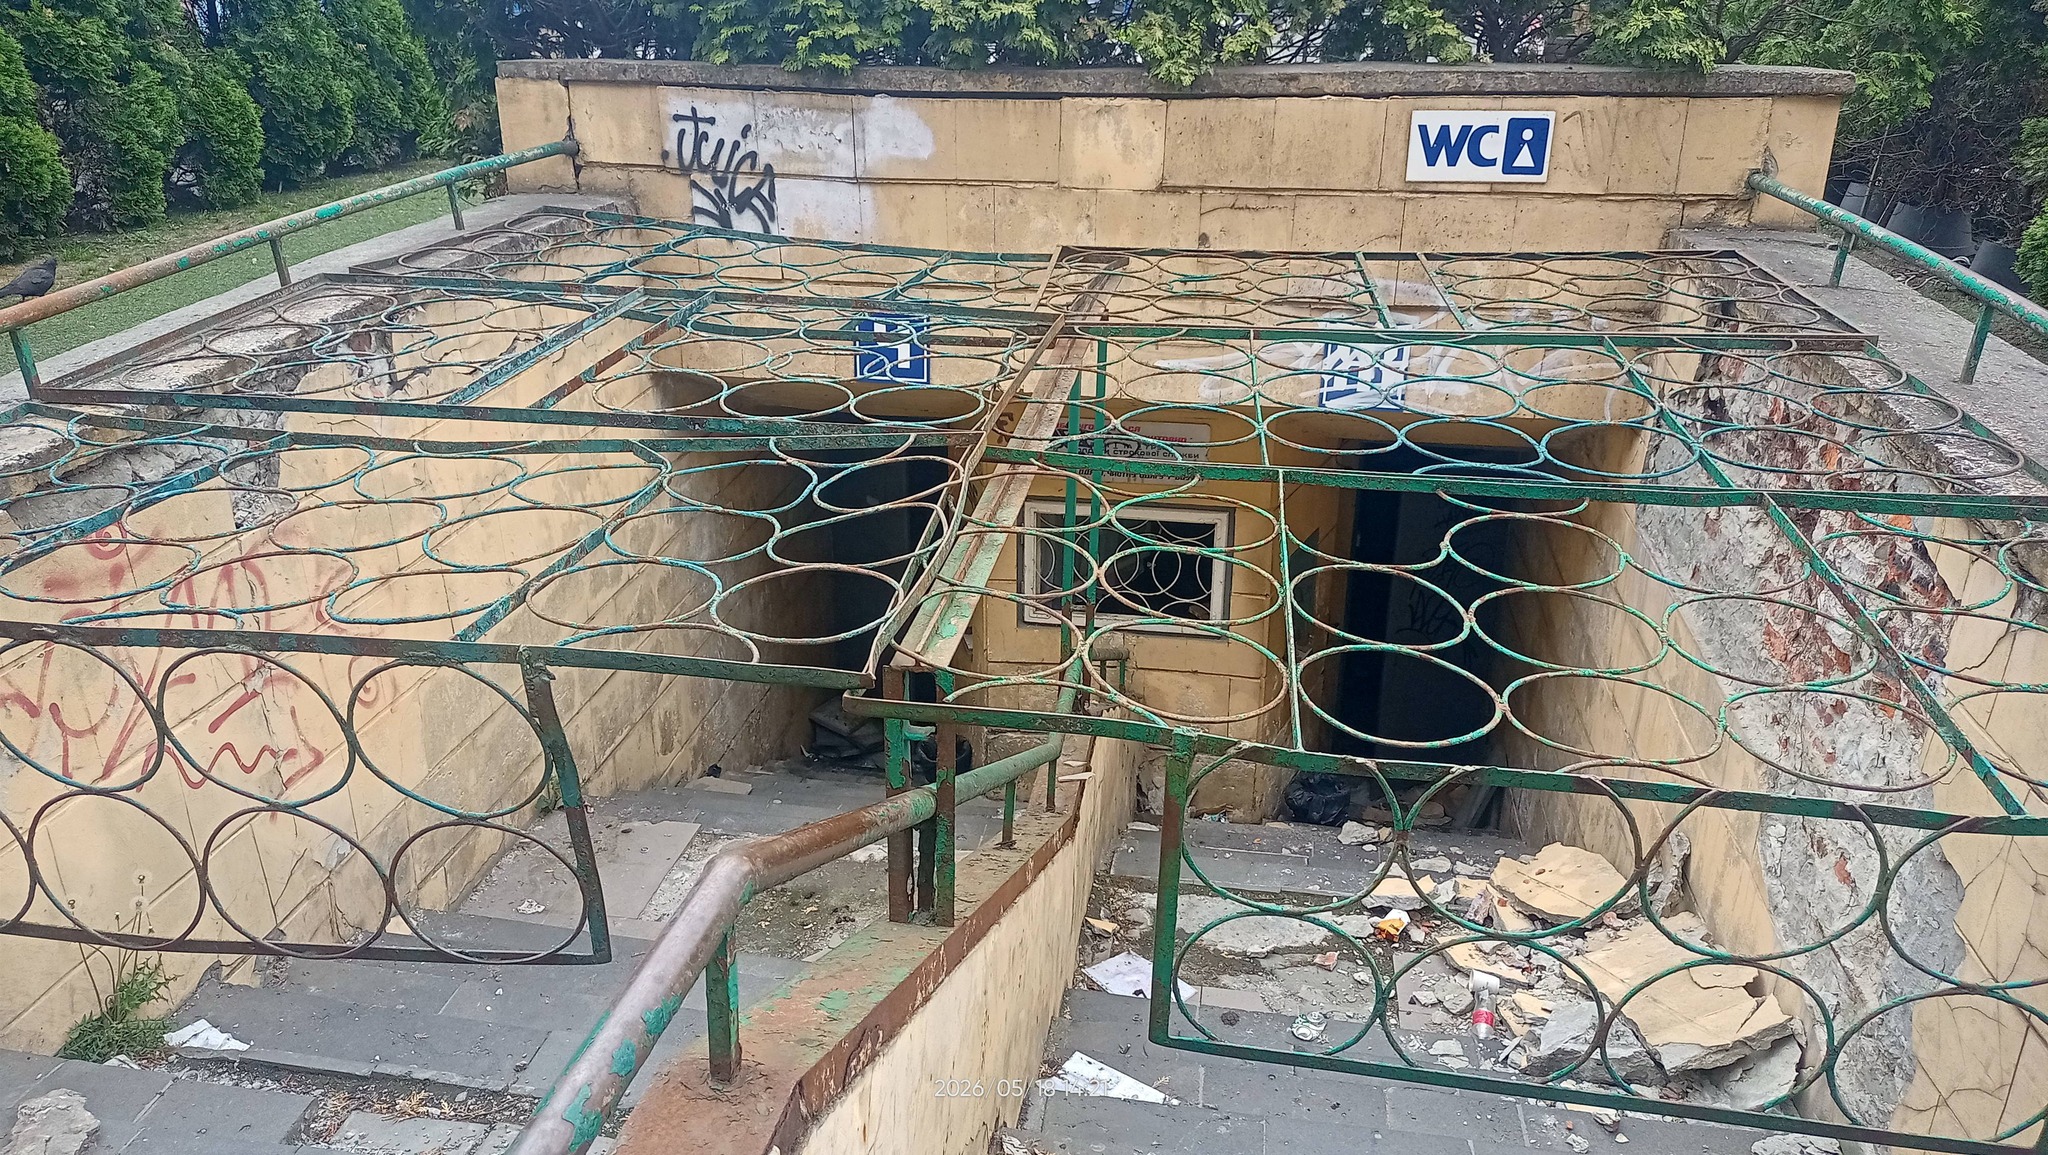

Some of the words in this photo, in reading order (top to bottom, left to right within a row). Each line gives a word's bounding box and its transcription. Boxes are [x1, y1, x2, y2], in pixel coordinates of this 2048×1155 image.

[1417, 124, 1500, 168] WC
[1113, 448, 1160, 458] СТРОКОВОЇ
[1162, 451, 1200, 460] СЛЖБИ
